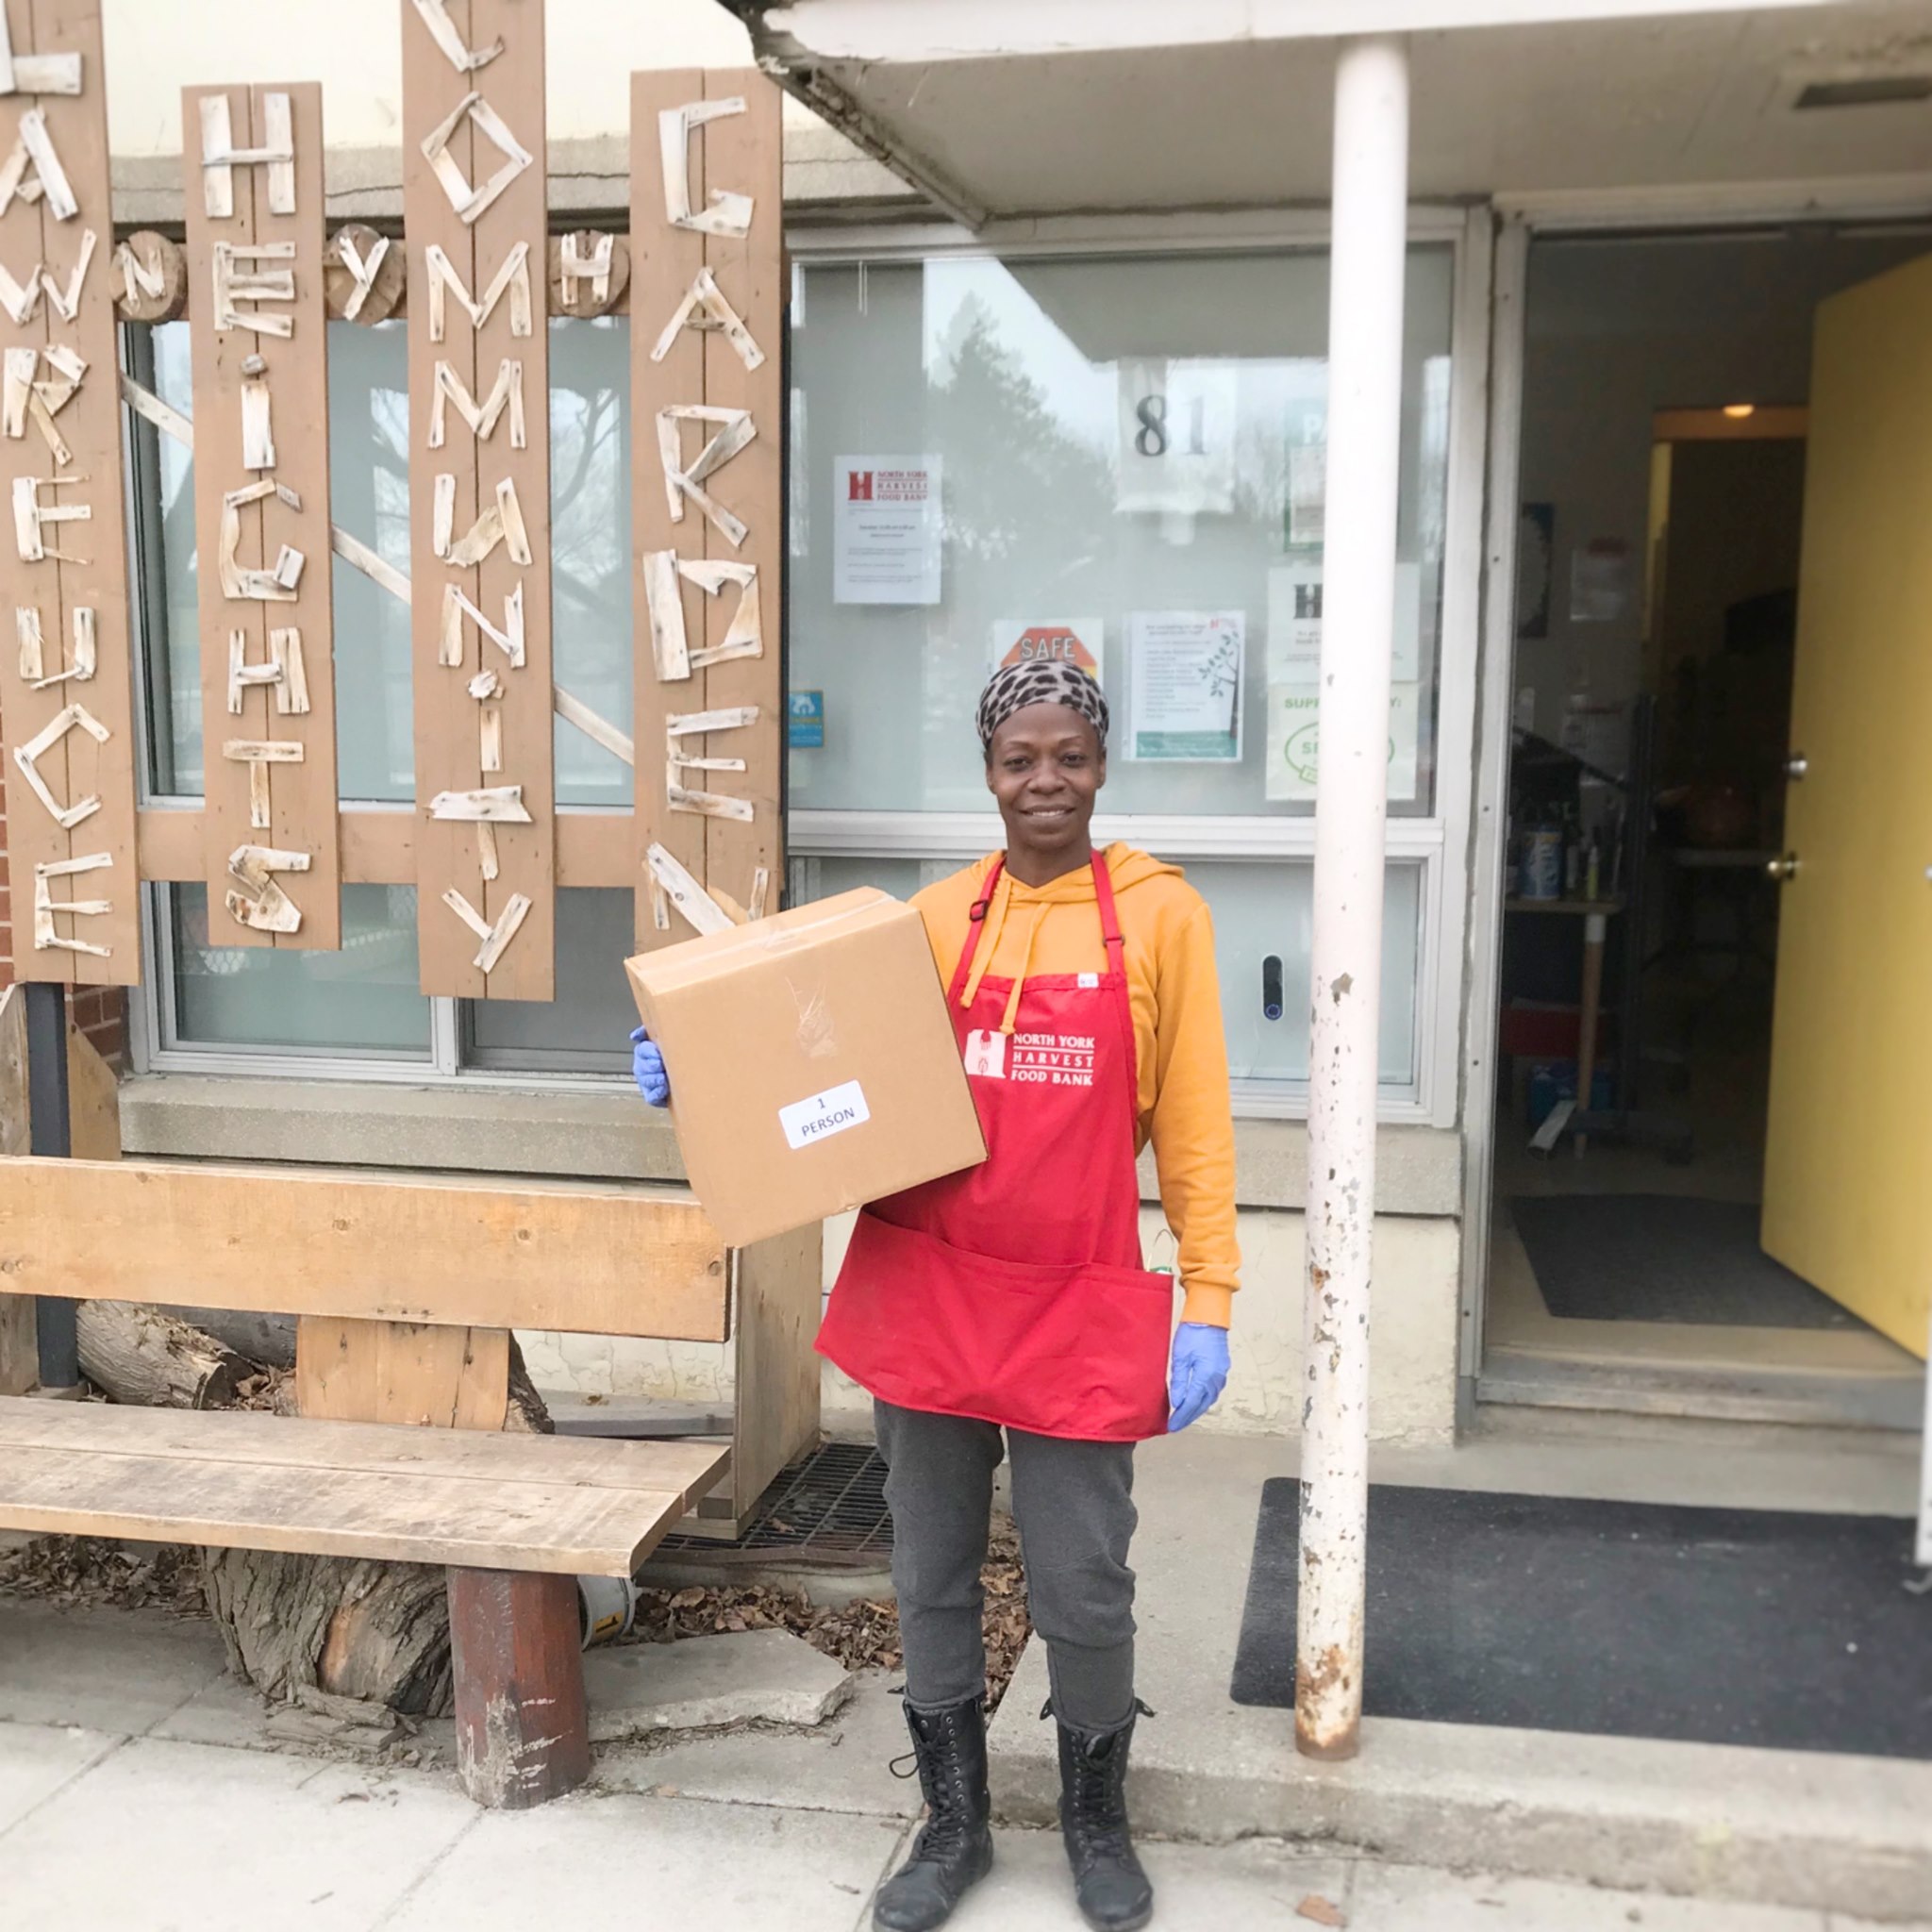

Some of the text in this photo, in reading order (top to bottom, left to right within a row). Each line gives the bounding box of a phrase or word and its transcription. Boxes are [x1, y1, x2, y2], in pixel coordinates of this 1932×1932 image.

[560, 233, 614, 306] H
[1135, 394, 1209, 457] 81
[1021, 637, 1075, 658] SAFE
[1013, 1033, 1095, 1049] NORTH YORK
[1012, 1051, 1094, 1068] HARVEST
[1010, 1070, 1093, 1086] FOOD BANK
[818, 1098, 825, 1109] 1
[801, 1108, 856, 1137] PERSON
